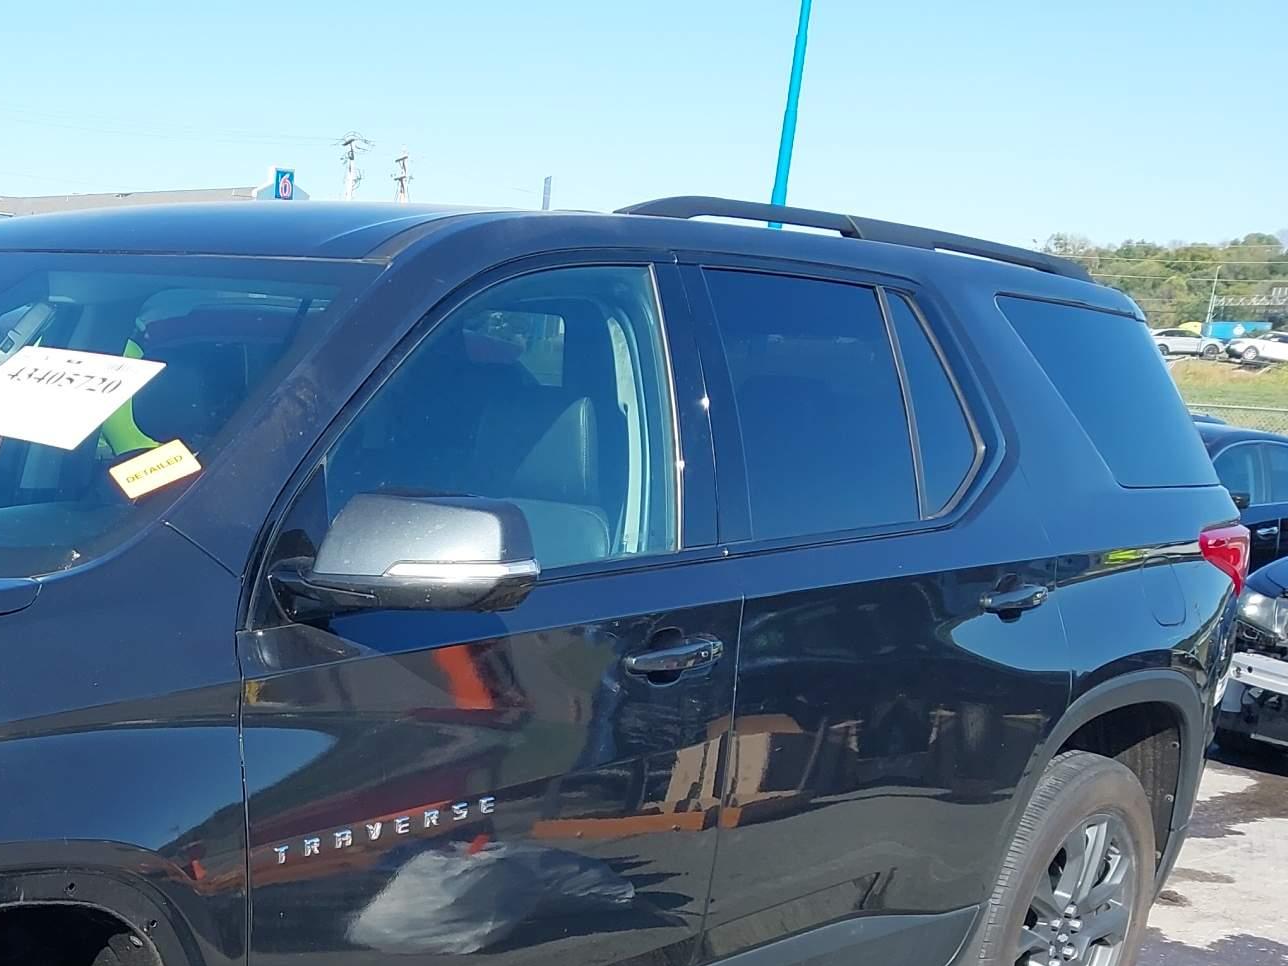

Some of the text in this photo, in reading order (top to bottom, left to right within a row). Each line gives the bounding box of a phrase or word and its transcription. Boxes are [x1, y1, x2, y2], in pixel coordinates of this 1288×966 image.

[279, 172, 292, 198] 6
[8, 367, 123, 393] 43405720
[125, 454, 184, 484] DETAILED
[274, 796, 496, 865] TRAVERSE
